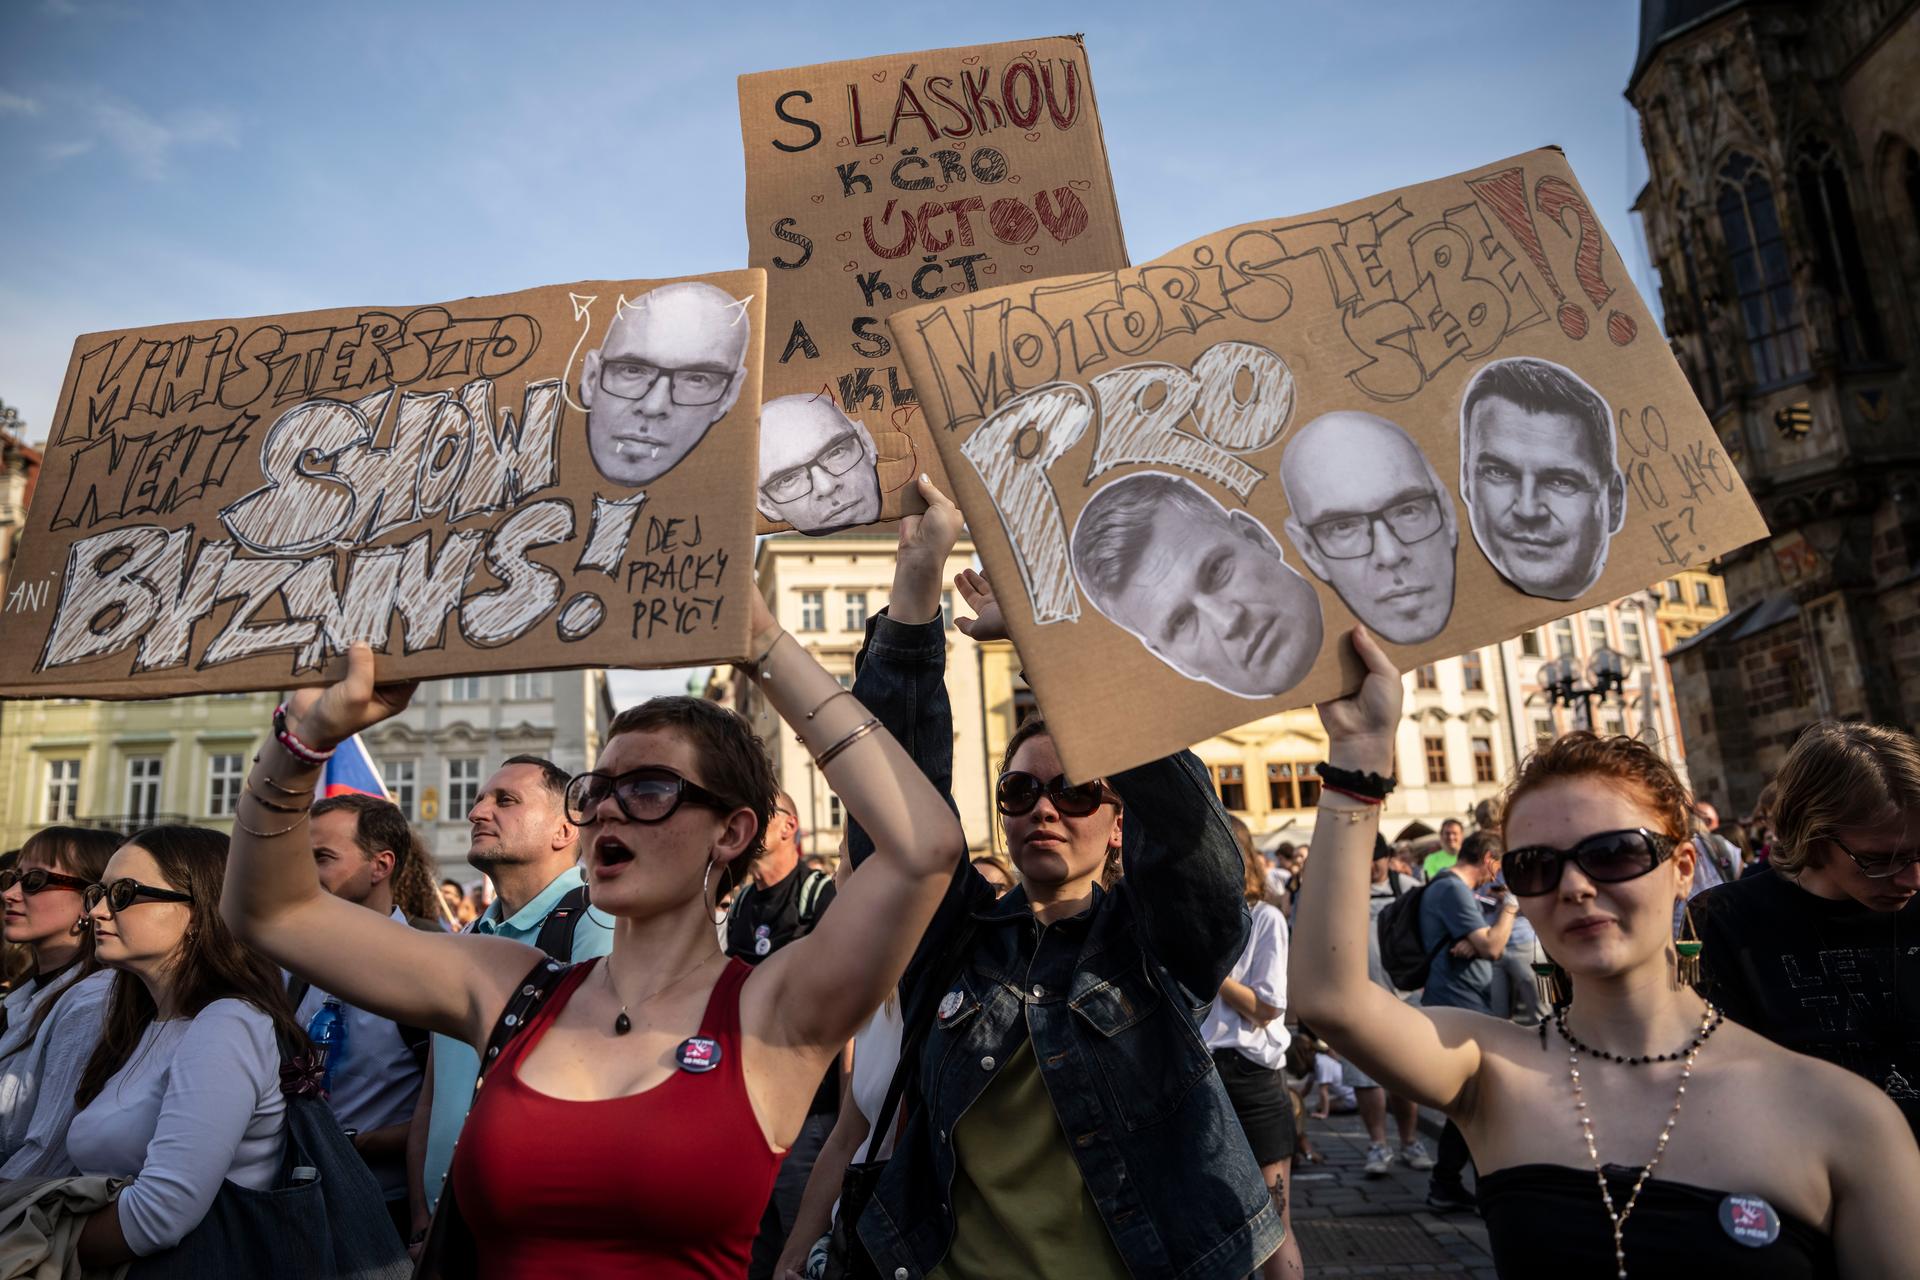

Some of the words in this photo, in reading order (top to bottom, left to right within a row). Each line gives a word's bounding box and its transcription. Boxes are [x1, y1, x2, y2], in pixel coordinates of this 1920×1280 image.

[772, 91, 822, 152] S
[847, 58, 1081, 147] LÁSKOU
[835, 160, 872, 197] K
[890, 145, 1008, 190] ČRO
[771, 217, 813, 270] S
[863, 186, 1089, 259] ÚCTOU
[856, 269, 893, 307] K
[911, 254, 987, 300] ČT
[779, 319, 820, 364] A
[851, 316, 891, 358] S
[837, 366, 919, 413] KL
[1619, 405, 1668, 458] CO
[216, 377, 569, 556] SHOW
[960, 340, 1297, 625] PRO
[1625, 457, 1669, 511] TO
[1671, 439, 1734, 505] JAKO
[645, 515, 702, 556] DEJ
[1651, 506, 1706, 567] JE?
[4, 579, 51, 614] ANI
[32, 490, 648, 677] BYZNYS!
[627, 548, 729, 594] PRACKY
[632, 595, 724, 640] PRYČ!
